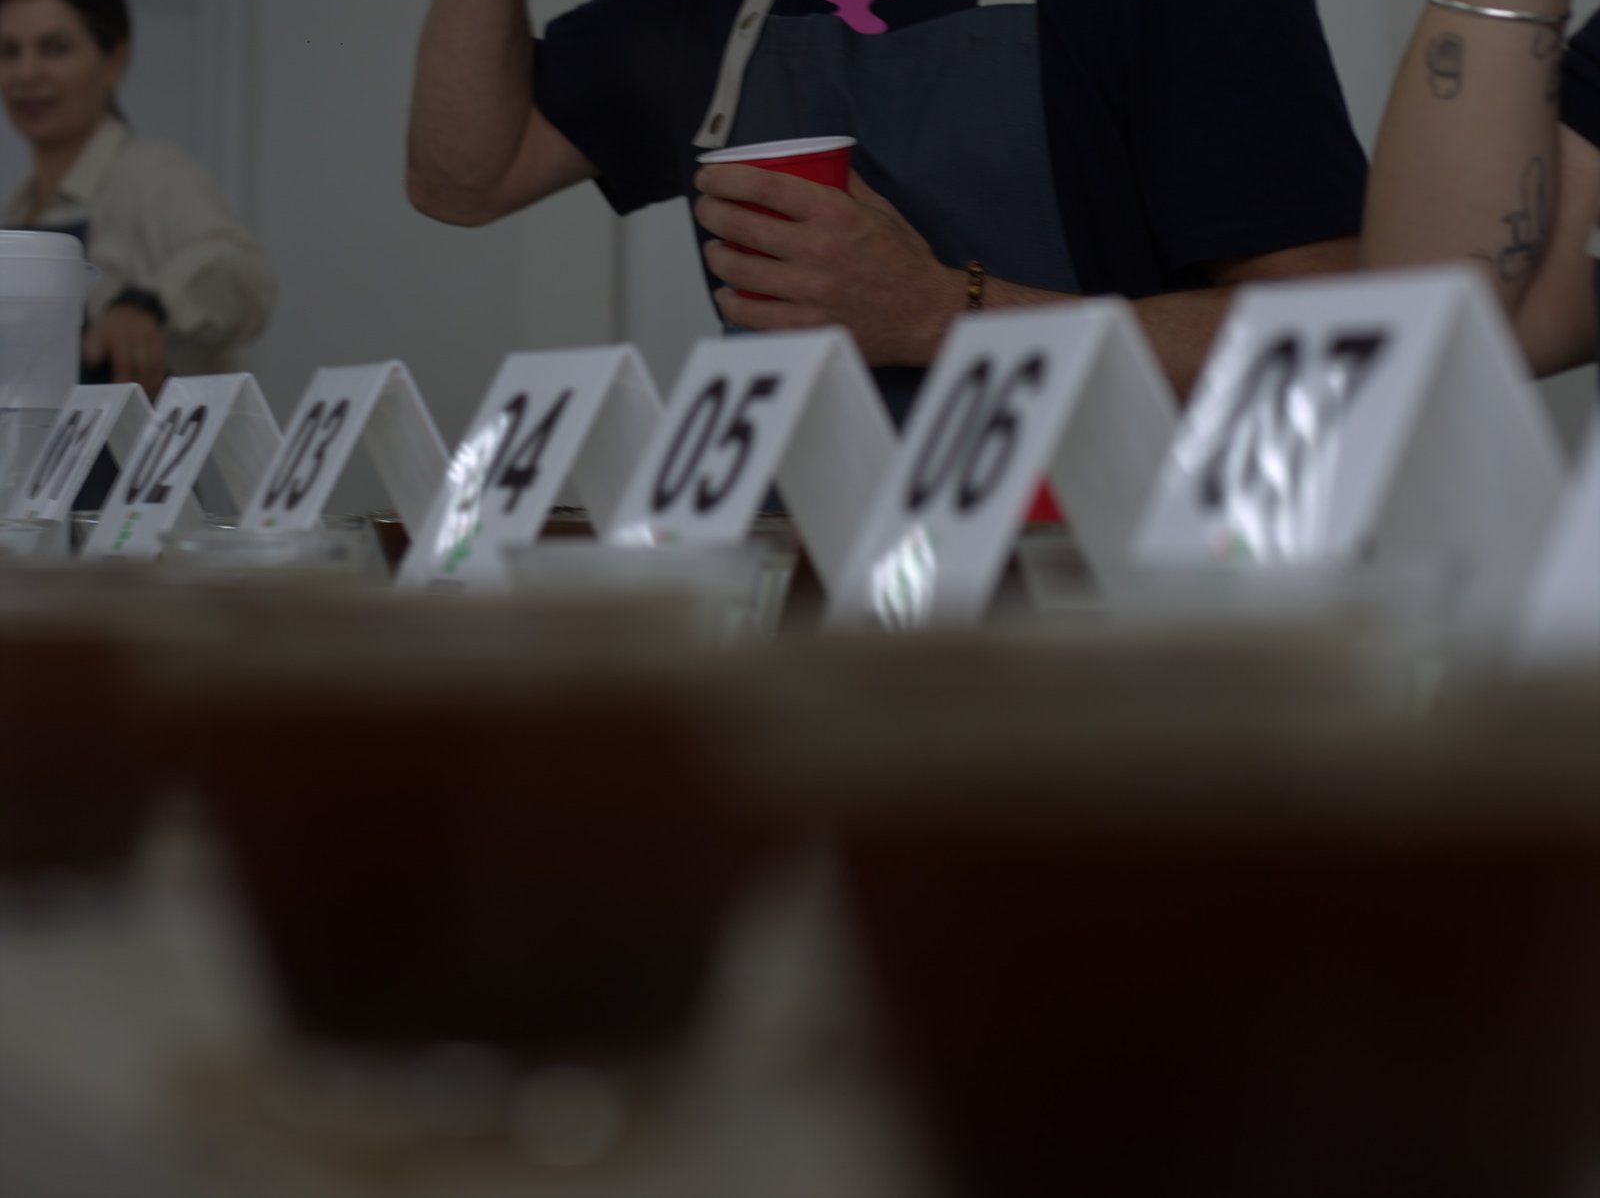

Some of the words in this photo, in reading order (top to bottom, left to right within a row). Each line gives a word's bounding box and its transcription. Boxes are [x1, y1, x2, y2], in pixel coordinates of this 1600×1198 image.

[27, 408, 106, 501] 01
[125, 404, 208, 505] 02
[262, 399, 350, 510] 03
[650, 374, 782, 514] 05
[905, 352, 1049, 512] 06
